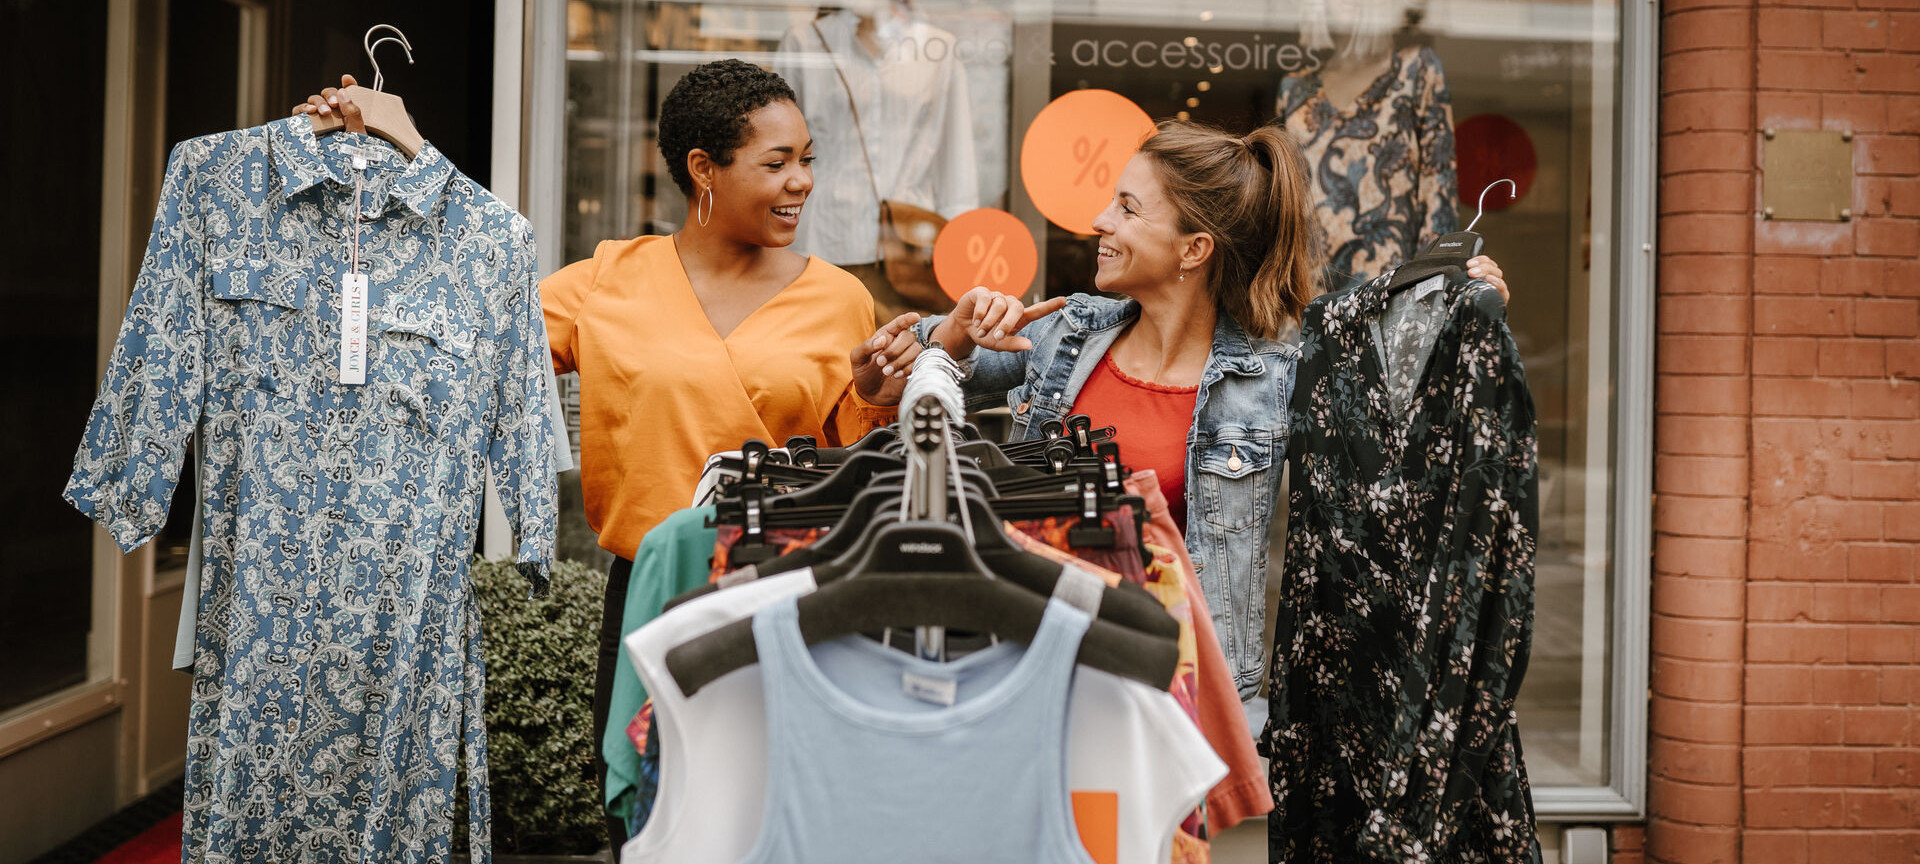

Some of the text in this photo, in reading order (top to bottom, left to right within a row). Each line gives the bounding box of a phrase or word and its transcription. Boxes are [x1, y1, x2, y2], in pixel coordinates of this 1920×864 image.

[1072, 34, 1321, 71] accessoires
[1073, 136, 1110, 188] %
[967, 234, 1009, 285] %
[349, 286, 361, 372] JOYCE & GIRLS
